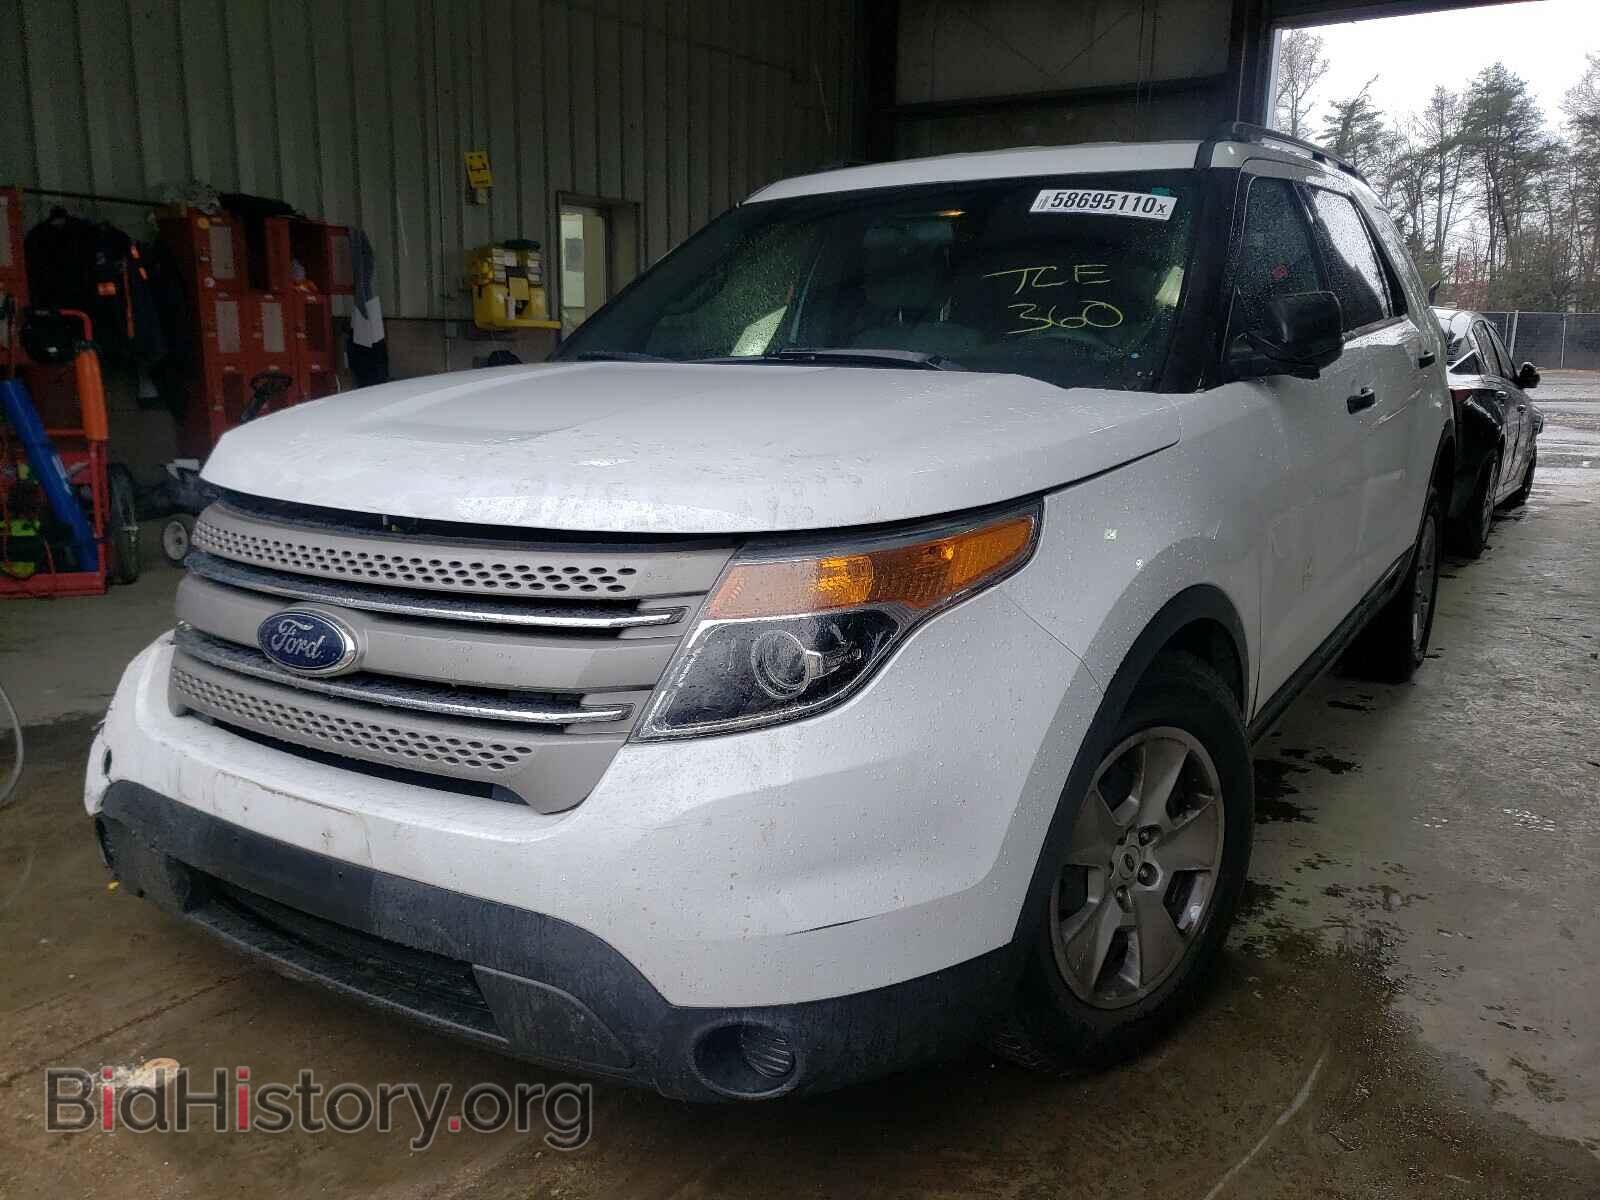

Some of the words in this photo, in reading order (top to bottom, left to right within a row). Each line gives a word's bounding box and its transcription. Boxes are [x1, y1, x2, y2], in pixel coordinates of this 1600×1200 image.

[982, 264, 1111, 295] TCE
[1007, 300, 1123, 335] 360
[271, 618, 326, 660] Ford
